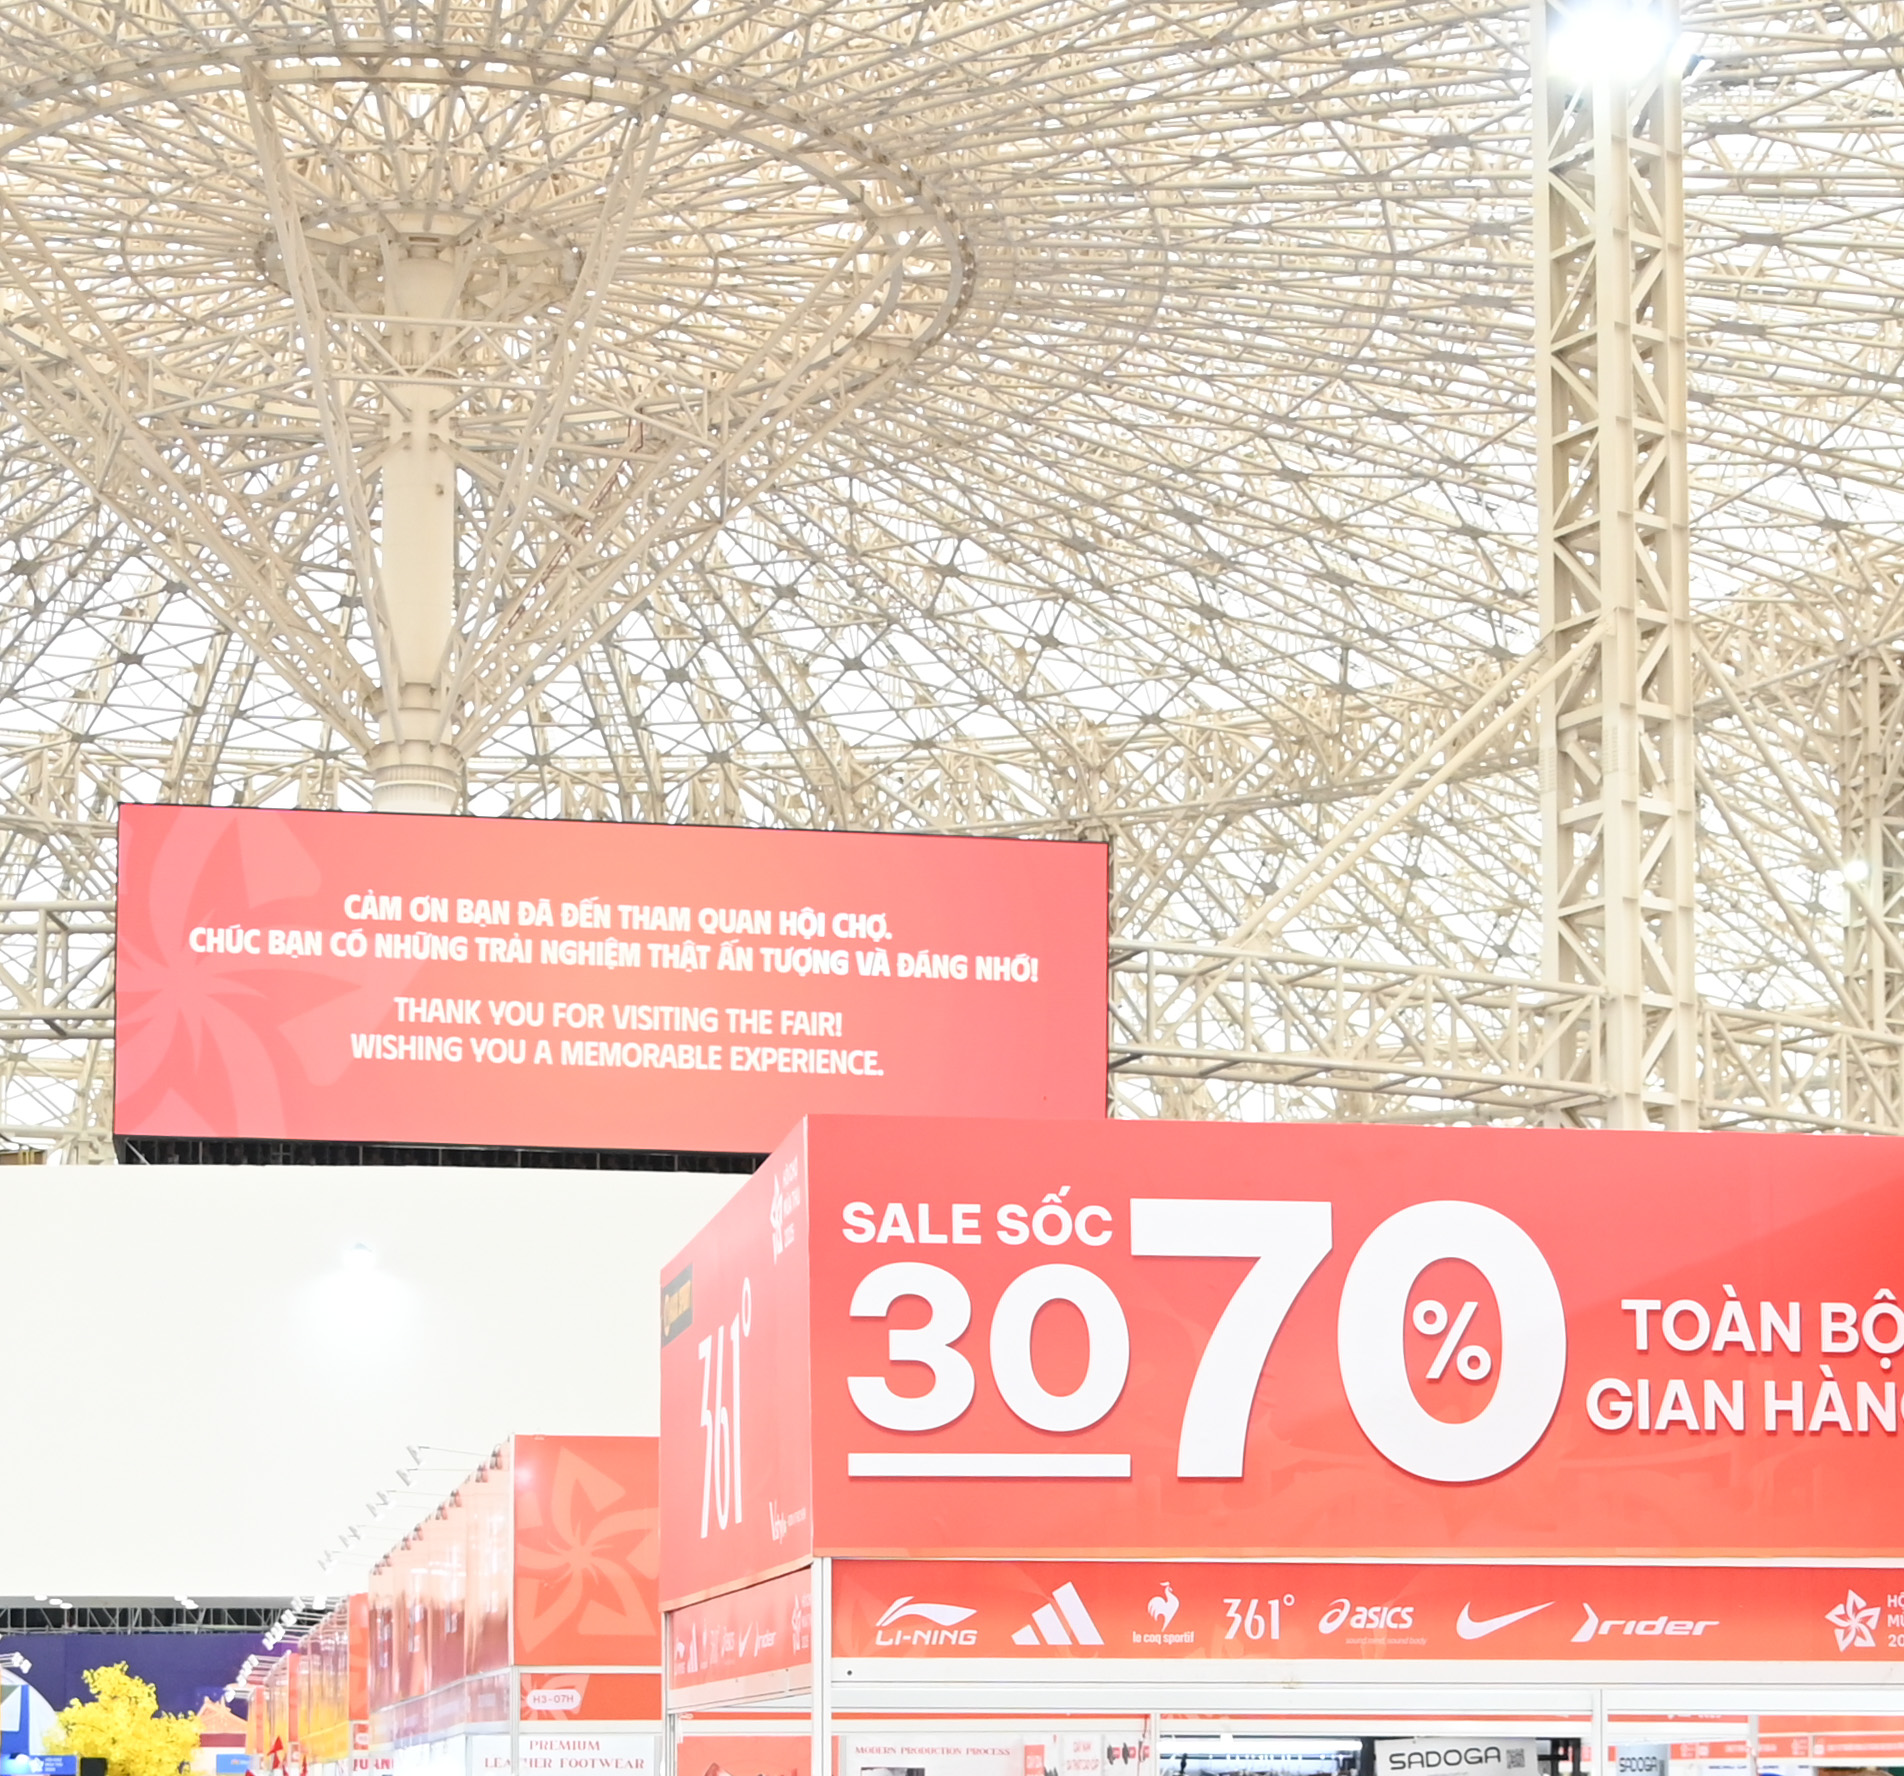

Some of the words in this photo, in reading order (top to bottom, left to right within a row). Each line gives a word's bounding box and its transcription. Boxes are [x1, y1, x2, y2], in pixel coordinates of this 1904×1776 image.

[343, 888, 403, 922] CẢM
[409, 895, 449, 923] ƠN
[456, 898, 511, 928] BẠN
[517, 898, 555, 927] ĐÃ
[560, 896, 612, 929] ĐẾN
[617, 904, 691, 932] THAM
[697, 907, 772, 935] QUAN
[779, 906, 826, 940] HỘI
[831, 912, 893, 943] CHỢ.
[188, 924, 261, 955] CHÚC
[268, 929, 323, 959] BẠN
[329, 927, 368, 958] CÓ
[374, 930, 469, 962] NHỮNG
[473, 932, 533, 964] TRẢI
[540, 936, 641, 970] NGHIỆM
[647, 939, 712, 973] THẬT
[716, 938, 754, 972] ẤN
[759, 946, 850, 977] TƯỢNG
[855, 947, 892, 977] VÀ
[896, 949, 968, 980] ĐÁNG
[975, 953, 1039, 983] NHỚ!
[393, 996, 482, 1025] THANK
[487, 1000, 545, 1027] YOU
[552, 1002, 605, 1029] FOR
[611, 1004, 719, 1033] VISITING
[724, 1008, 773, 1035] THE
[780, 1009, 843, 1038] FAIR!
[350, 1032, 463, 1063] WISHING
[469, 1037, 527, 1065] YOU
[533, 1039, 554, 1065] A
[560, 1040, 723, 1071] MEMORABLE
[730, 1045, 885, 1077] EXPERIENCE.
[842, 1201, 982, 1245] SALE
[996, 1185, 1113, 1247] SỐC
[1621, 1283, 1801, 1352] TOÀN
[847, 1261, 1130, 1432] 30
[1586, 1377, 1745, 1431] GIAN
[1223, 1593, 1295, 1641] 361°
[1350, 1605, 1414, 1630] asics
[1597, 1616, 1720, 1636] rider
[875, 1629, 978, 1647] LI-NING
[1133, 1630, 1142, 1643] le
[1145, 1632, 1162, 1645] coq
[1164, 1630, 1194, 1645] sportif
[532, 1695, 574, 1704] H3-07H
[529, 1740, 600, 1751] PREMIUM
[855, 1746, 897, 1755] MODERN
[900, 1746, 962, 1756] PRODUCTION
[965, 1747, 1011, 1757] PROCESS
[560, 1757, 645, 1770] FOOTWEAR
[1389, 1746, 1501, 1771] SADOGA
[1619, 1756, 1658, 1773] SADOGA
